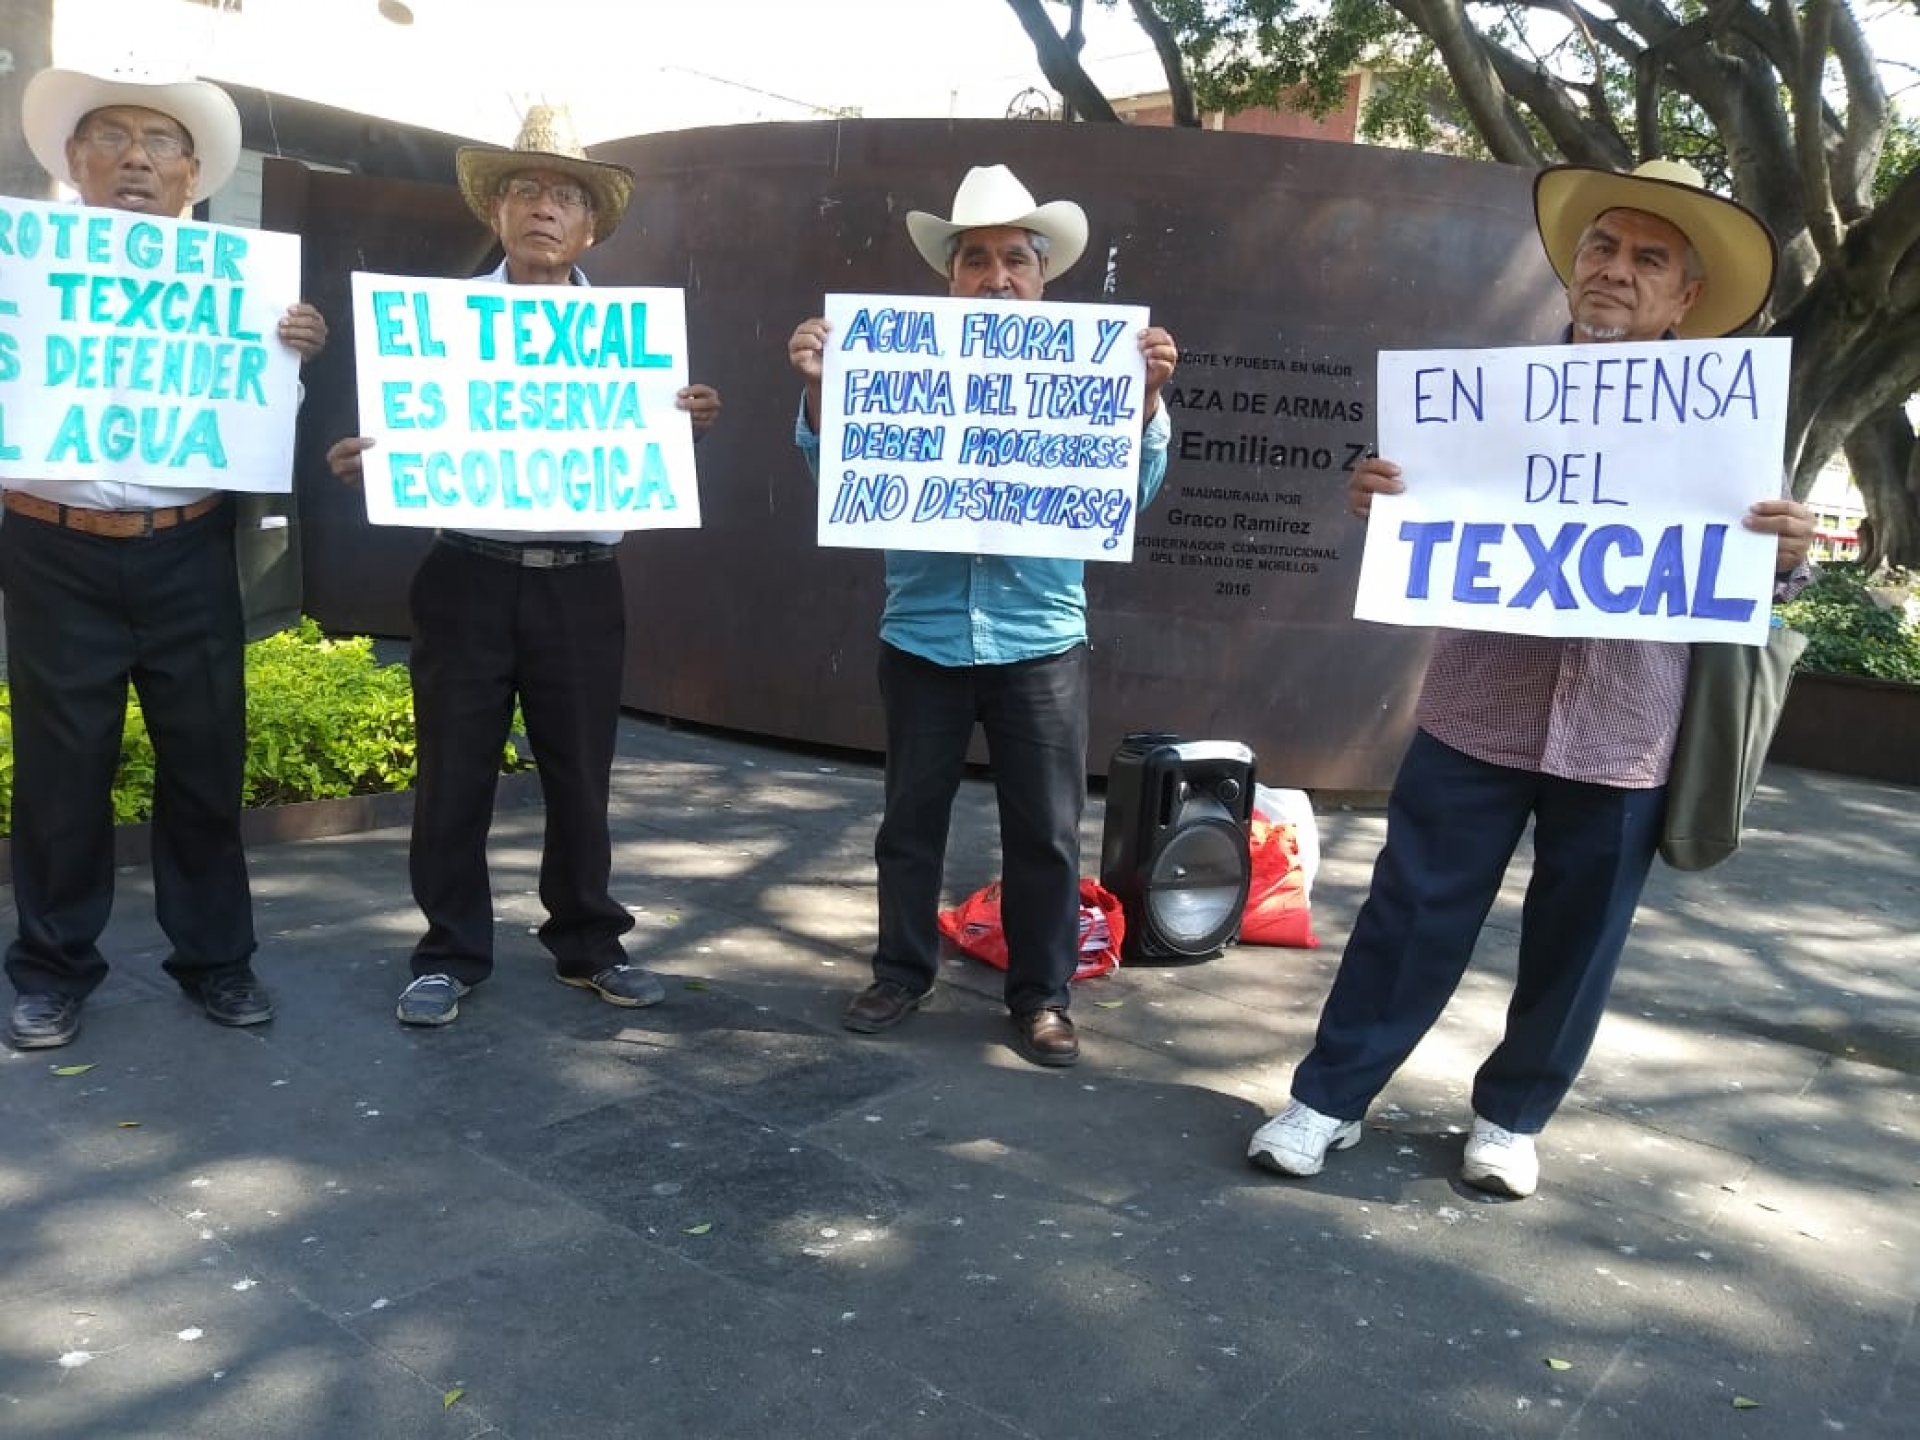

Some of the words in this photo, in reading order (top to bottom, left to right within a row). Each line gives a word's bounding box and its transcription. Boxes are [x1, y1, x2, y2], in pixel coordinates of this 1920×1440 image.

[46, 272, 262, 342] TEXCAL
[372, 291, 447, 357] EL
[465, 295, 673, 369] TEXCAL
[960, 313, 1074, 362] FLORA
[1091, 319, 1127, 364] Y
[44, 333, 268, 407] DEFENDER
[1223, 355, 1233, 368] Y
[1234, 356, 1286, 371] PUESTA
[1290, 361, 1308, 373] EN
[1312, 362, 1352, 377] VALOR
[1415, 367, 1485, 424] EN
[1525, 349, 1758, 425] DEFENSA
[382, 381, 446, 429] ES
[468, 380, 645, 432] RESERVA
[844, 369, 955, 416] FAUNA
[965, 374, 1017, 415] DEL
[1026, 373, 1136, 426] TEXCAL
[1232, 391, 1268, 414] DE
[1273, 395, 1364, 422] ARMAS
[46, 403, 228, 469] AGUA
[842, 422, 945, 463] DEBEN
[959, 426, 1132, 469] PROTEGERSE
[1180, 431, 1332, 470] Emiliano
[388, 443, 678, 512] ECOLOGICA
[1181, 486, 1269, 503] INAUGURADA
[1275, 494, 1302, 504] POR
[1525, 452, 1629, 506] DEL
[1168, 508, 1227, 529] Graco
[1150, 551, 1175, 564] DEL
[1181, 553, 1234, 568] ESTADO
[1236, 557, 1253, 569] DE
[1231, 542, 1340, 560] CONSTITUCIONAL
[1399, 521, 1758, 622] TEXCAL
[1214, 581, 1252, 596] 2016
